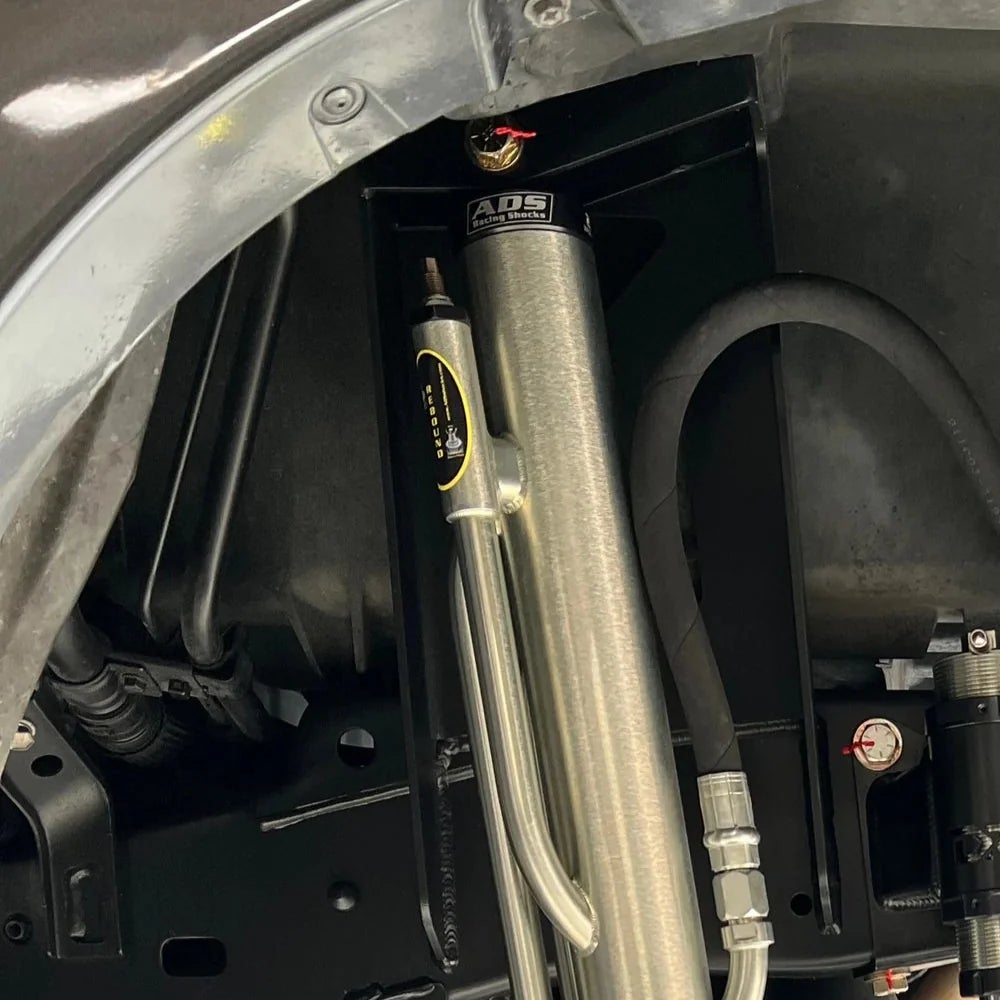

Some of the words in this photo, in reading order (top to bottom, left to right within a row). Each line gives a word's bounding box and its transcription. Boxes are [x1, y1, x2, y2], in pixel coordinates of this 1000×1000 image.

[472, 195, 547, 220] ADS
[472, 214, 506, 229] Racing
[507, 211, 546, 220] Shocks
[425, 384, 444, 459] REBOUND
